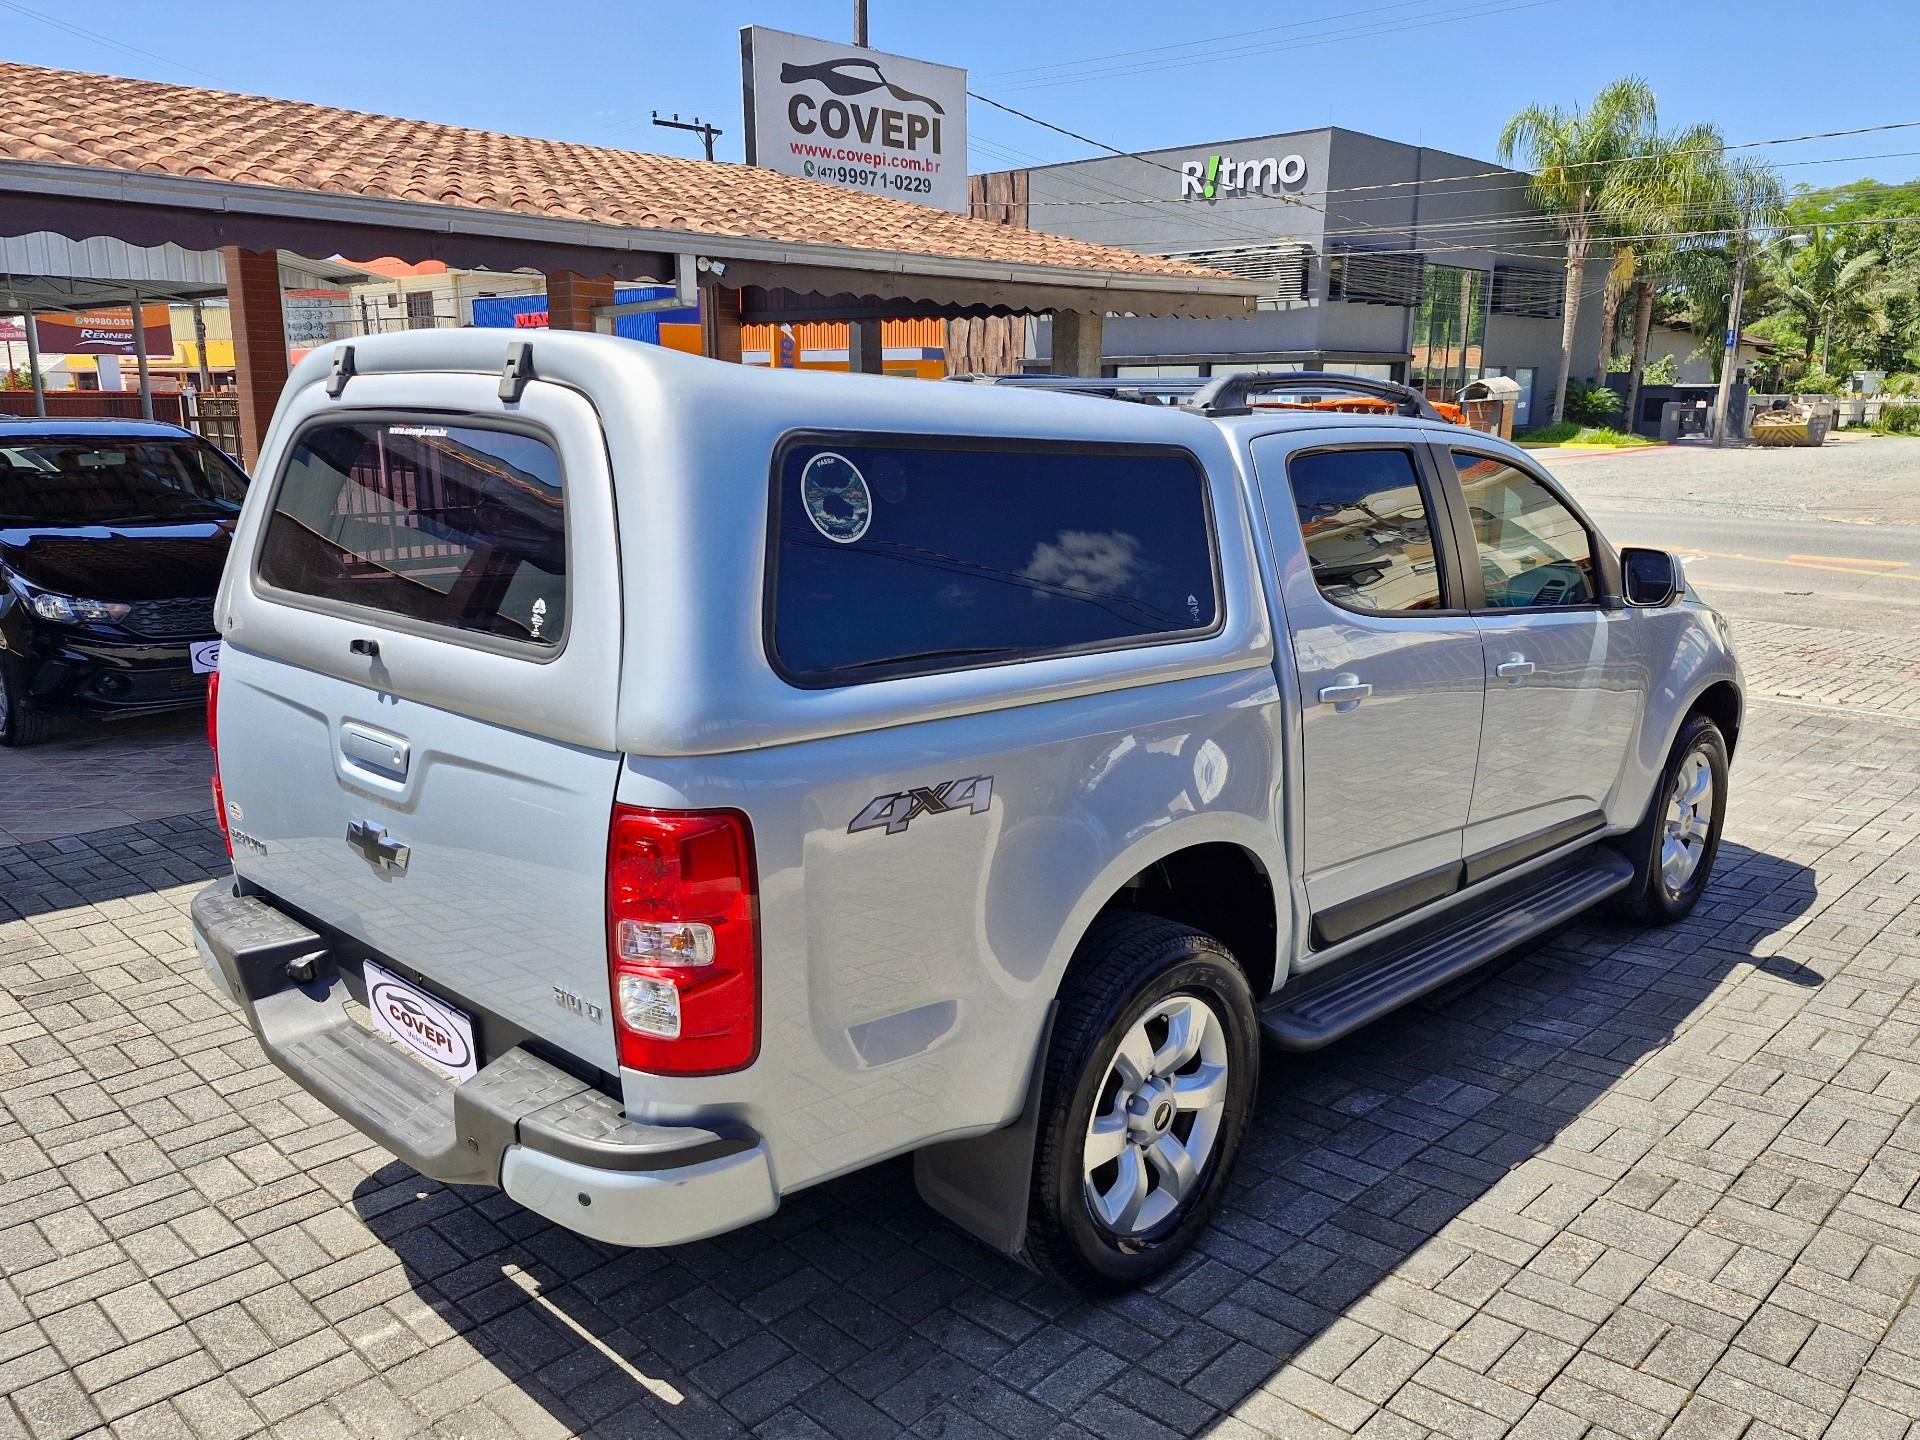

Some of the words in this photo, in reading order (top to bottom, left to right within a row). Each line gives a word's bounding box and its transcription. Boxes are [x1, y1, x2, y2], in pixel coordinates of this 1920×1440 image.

[788, 94, 941, 154] COVEPI
[790, 142, 941, 173] www.covepi.com.br
[389, 1004, 453, 1054] COVEPI
